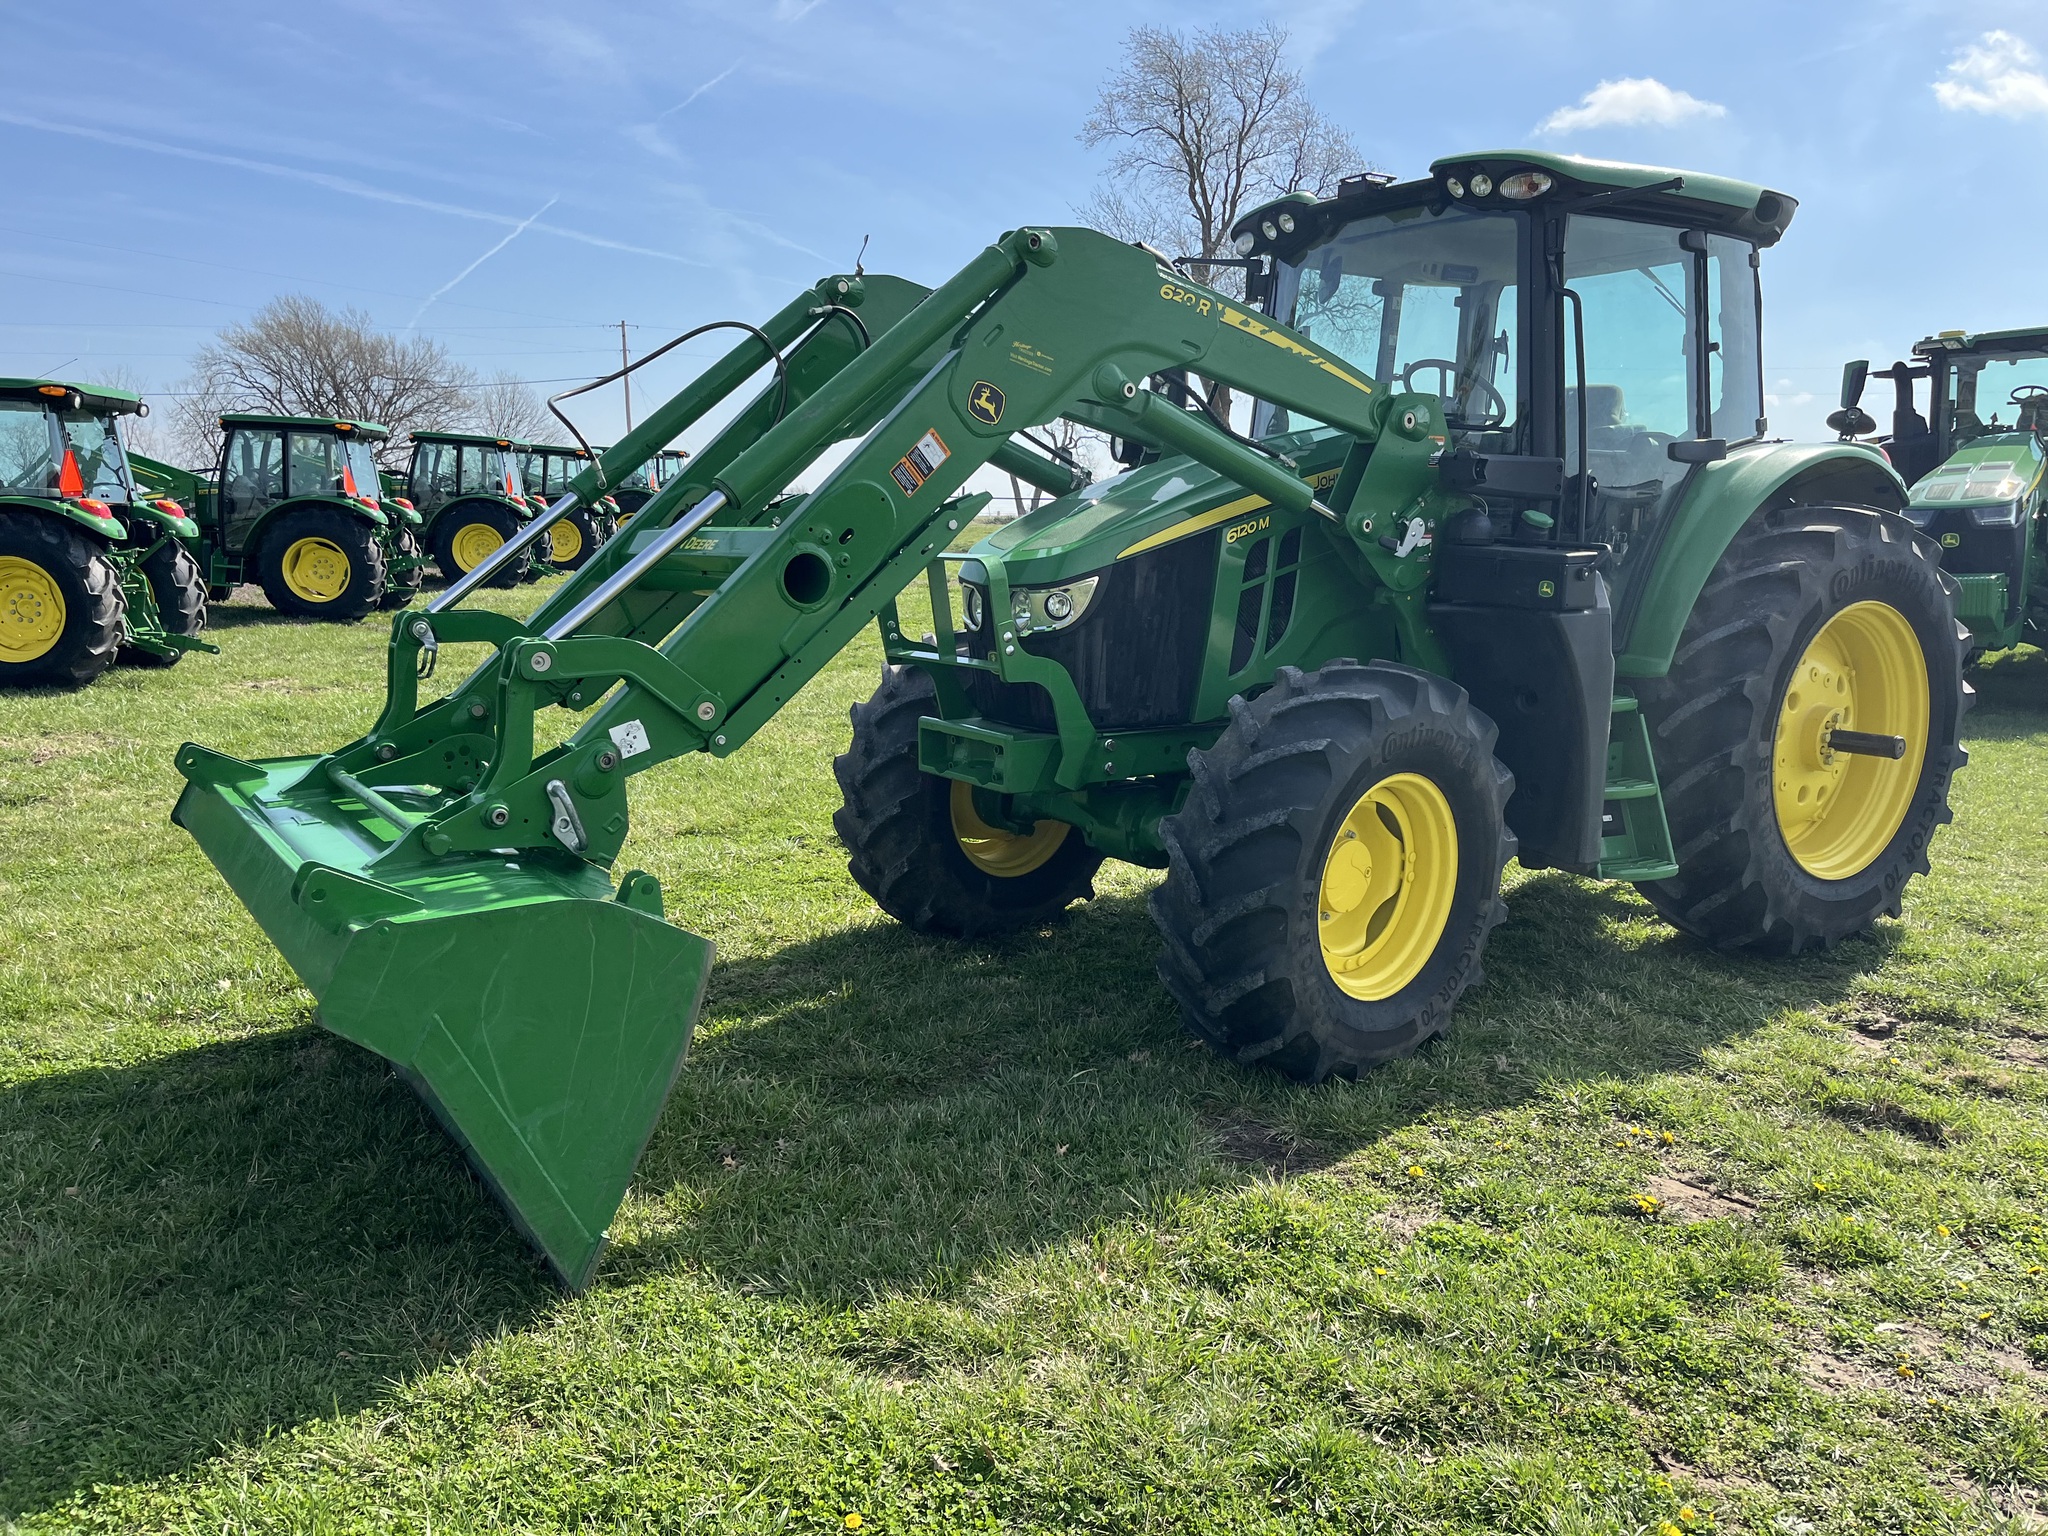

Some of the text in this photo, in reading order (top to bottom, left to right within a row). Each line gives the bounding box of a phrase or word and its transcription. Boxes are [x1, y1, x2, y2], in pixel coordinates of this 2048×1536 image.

[1159, 284, 1196, 307] 620
[684, 536, 719, 550] DEERE
[1226, 515, 1270, 544] 6120 M
[1829, 553, 1928, 604] Continental
[1381, 722, 1473, 768] Continental
[1884, 759, 1951, 891] TRACTOR 70
[1421, 912, 1488, 1026] TRACTOR 70
